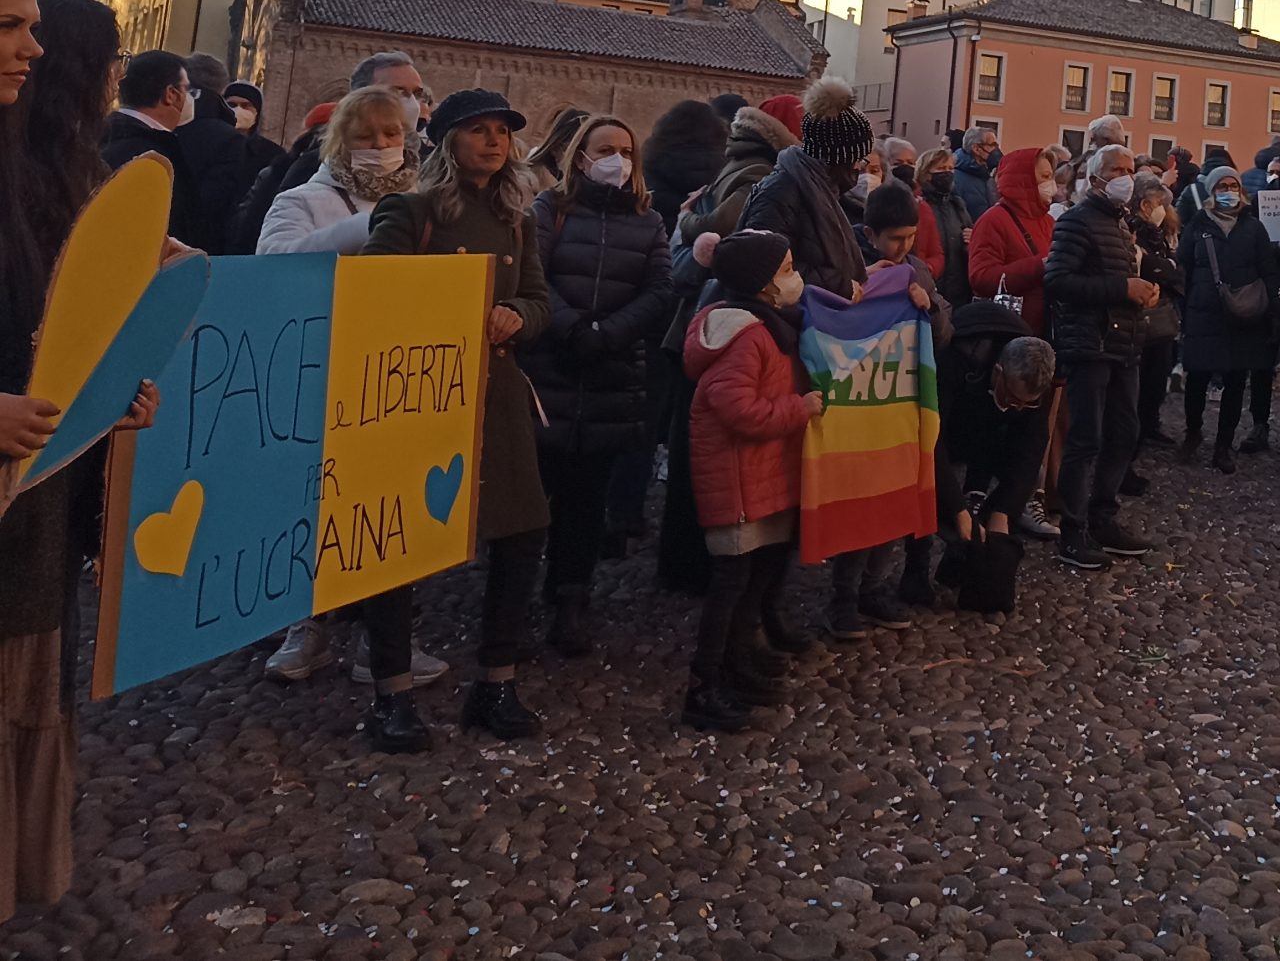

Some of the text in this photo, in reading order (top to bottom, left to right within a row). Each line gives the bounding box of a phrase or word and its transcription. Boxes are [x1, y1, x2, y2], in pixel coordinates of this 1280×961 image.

[183, 315, 328, 469] PACE
[304, 458, 339, 505] PER
[194, 494, 407, 630] L'UCRAINA
